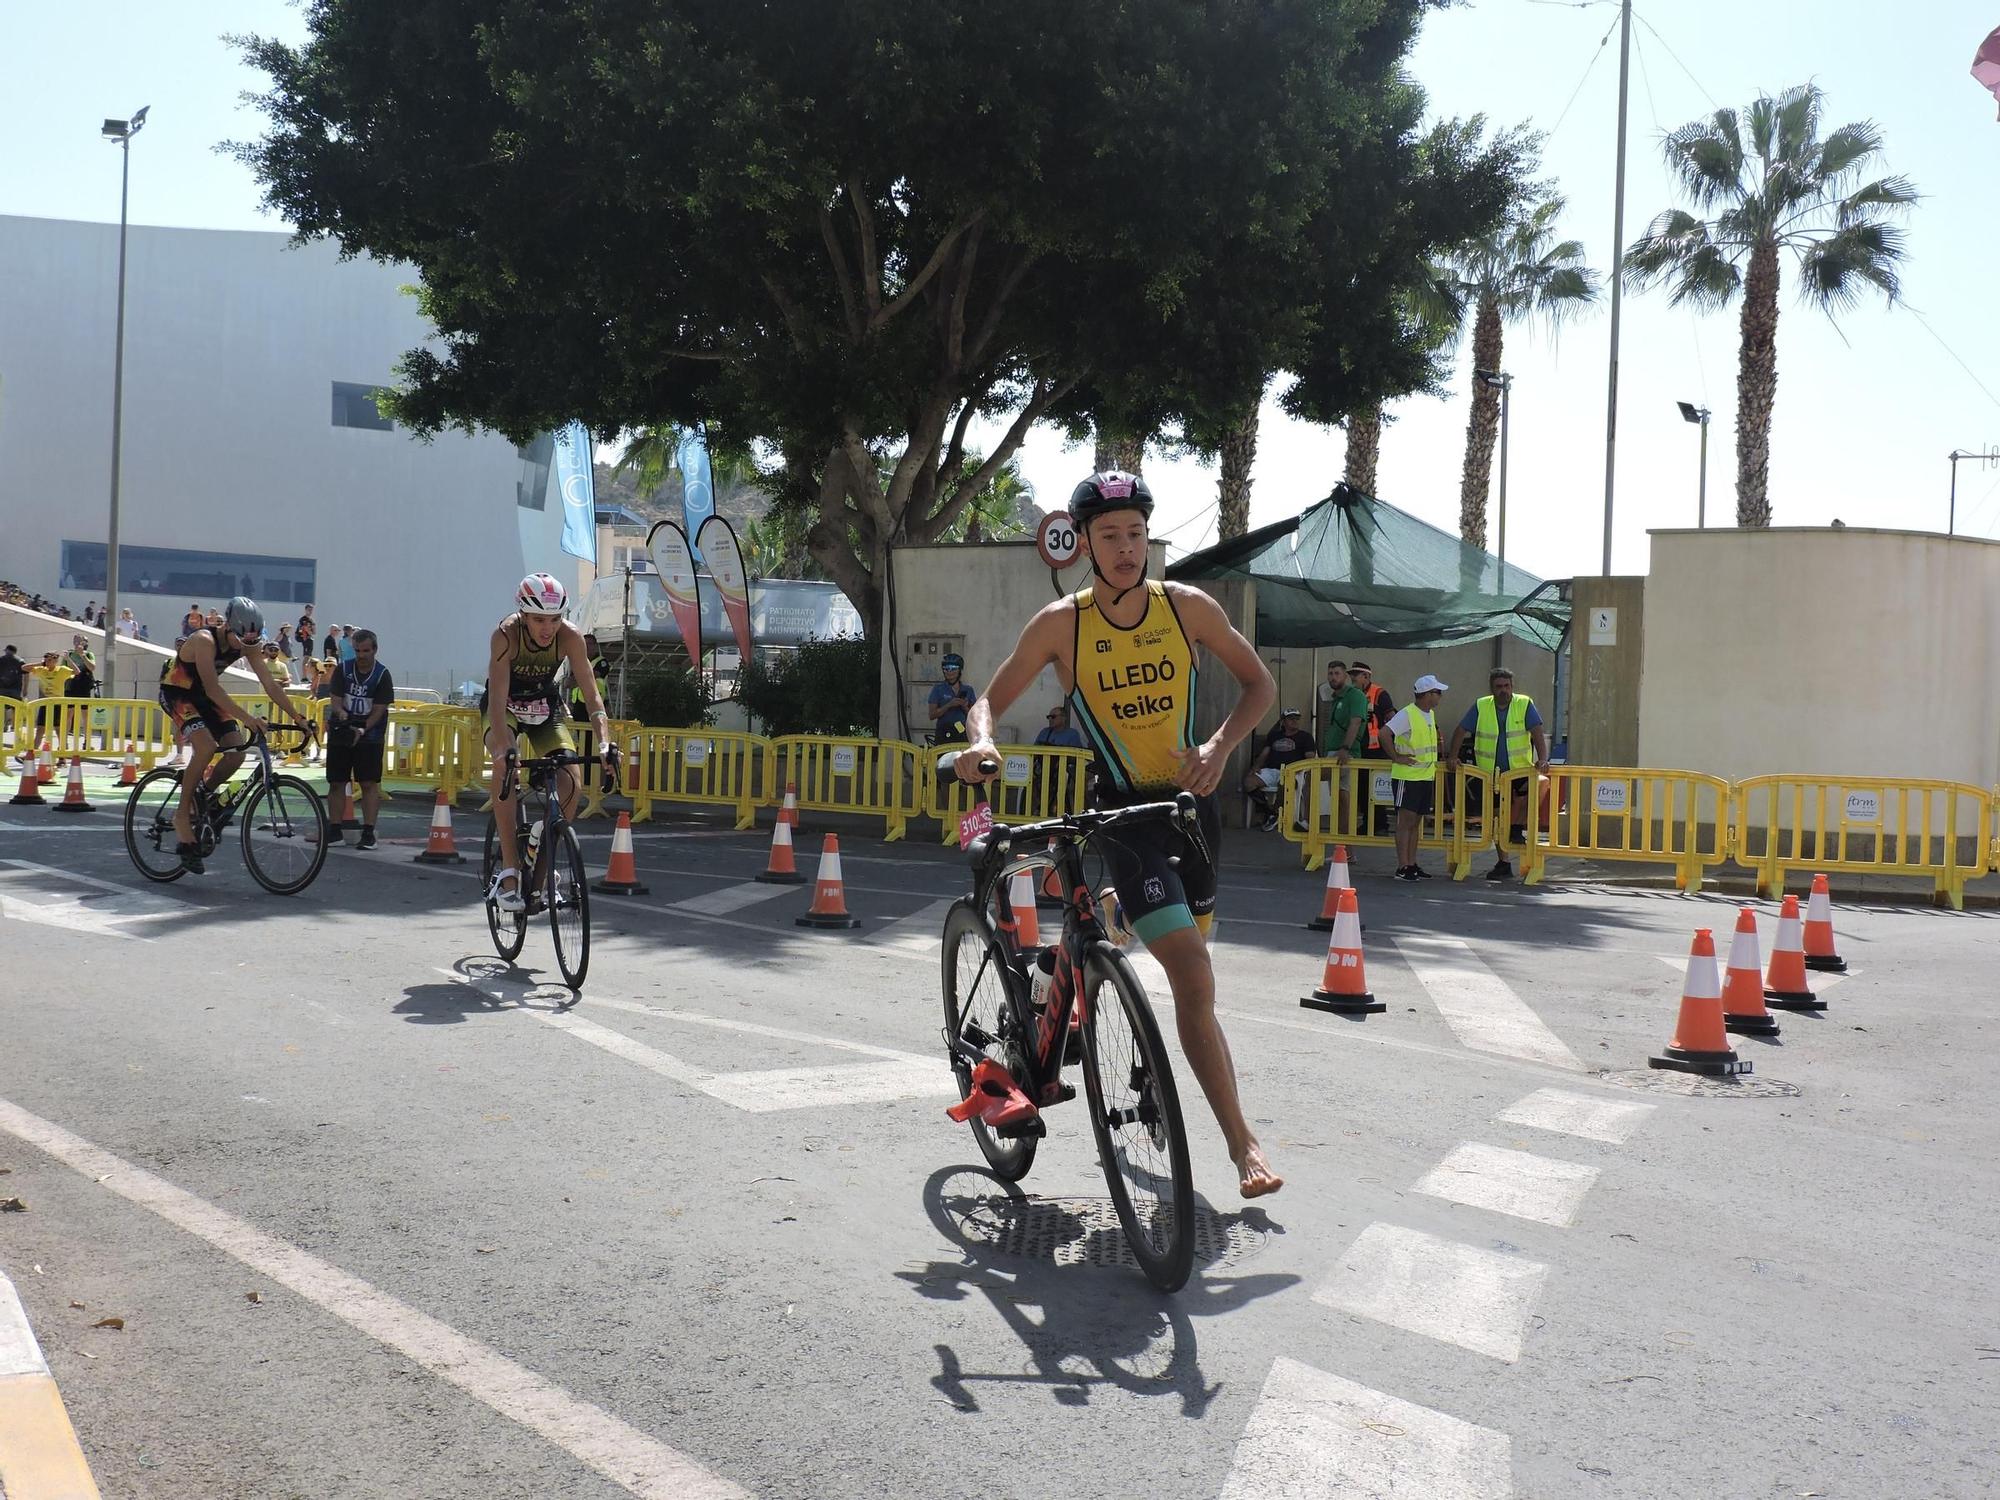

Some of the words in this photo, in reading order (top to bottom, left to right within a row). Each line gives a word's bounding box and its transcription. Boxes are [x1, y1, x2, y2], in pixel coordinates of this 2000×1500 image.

[1048, 528, 1075, 551] 30
[769, 607, 815, 616] PATRONATO
[769, 617, 815, 626] DEPORTIVO
[1098, 655, 1175, 692] LLEDÓ
[1112, 695, 1174, 720] teika
[1724, 1062, 1752, 1074] PDM
